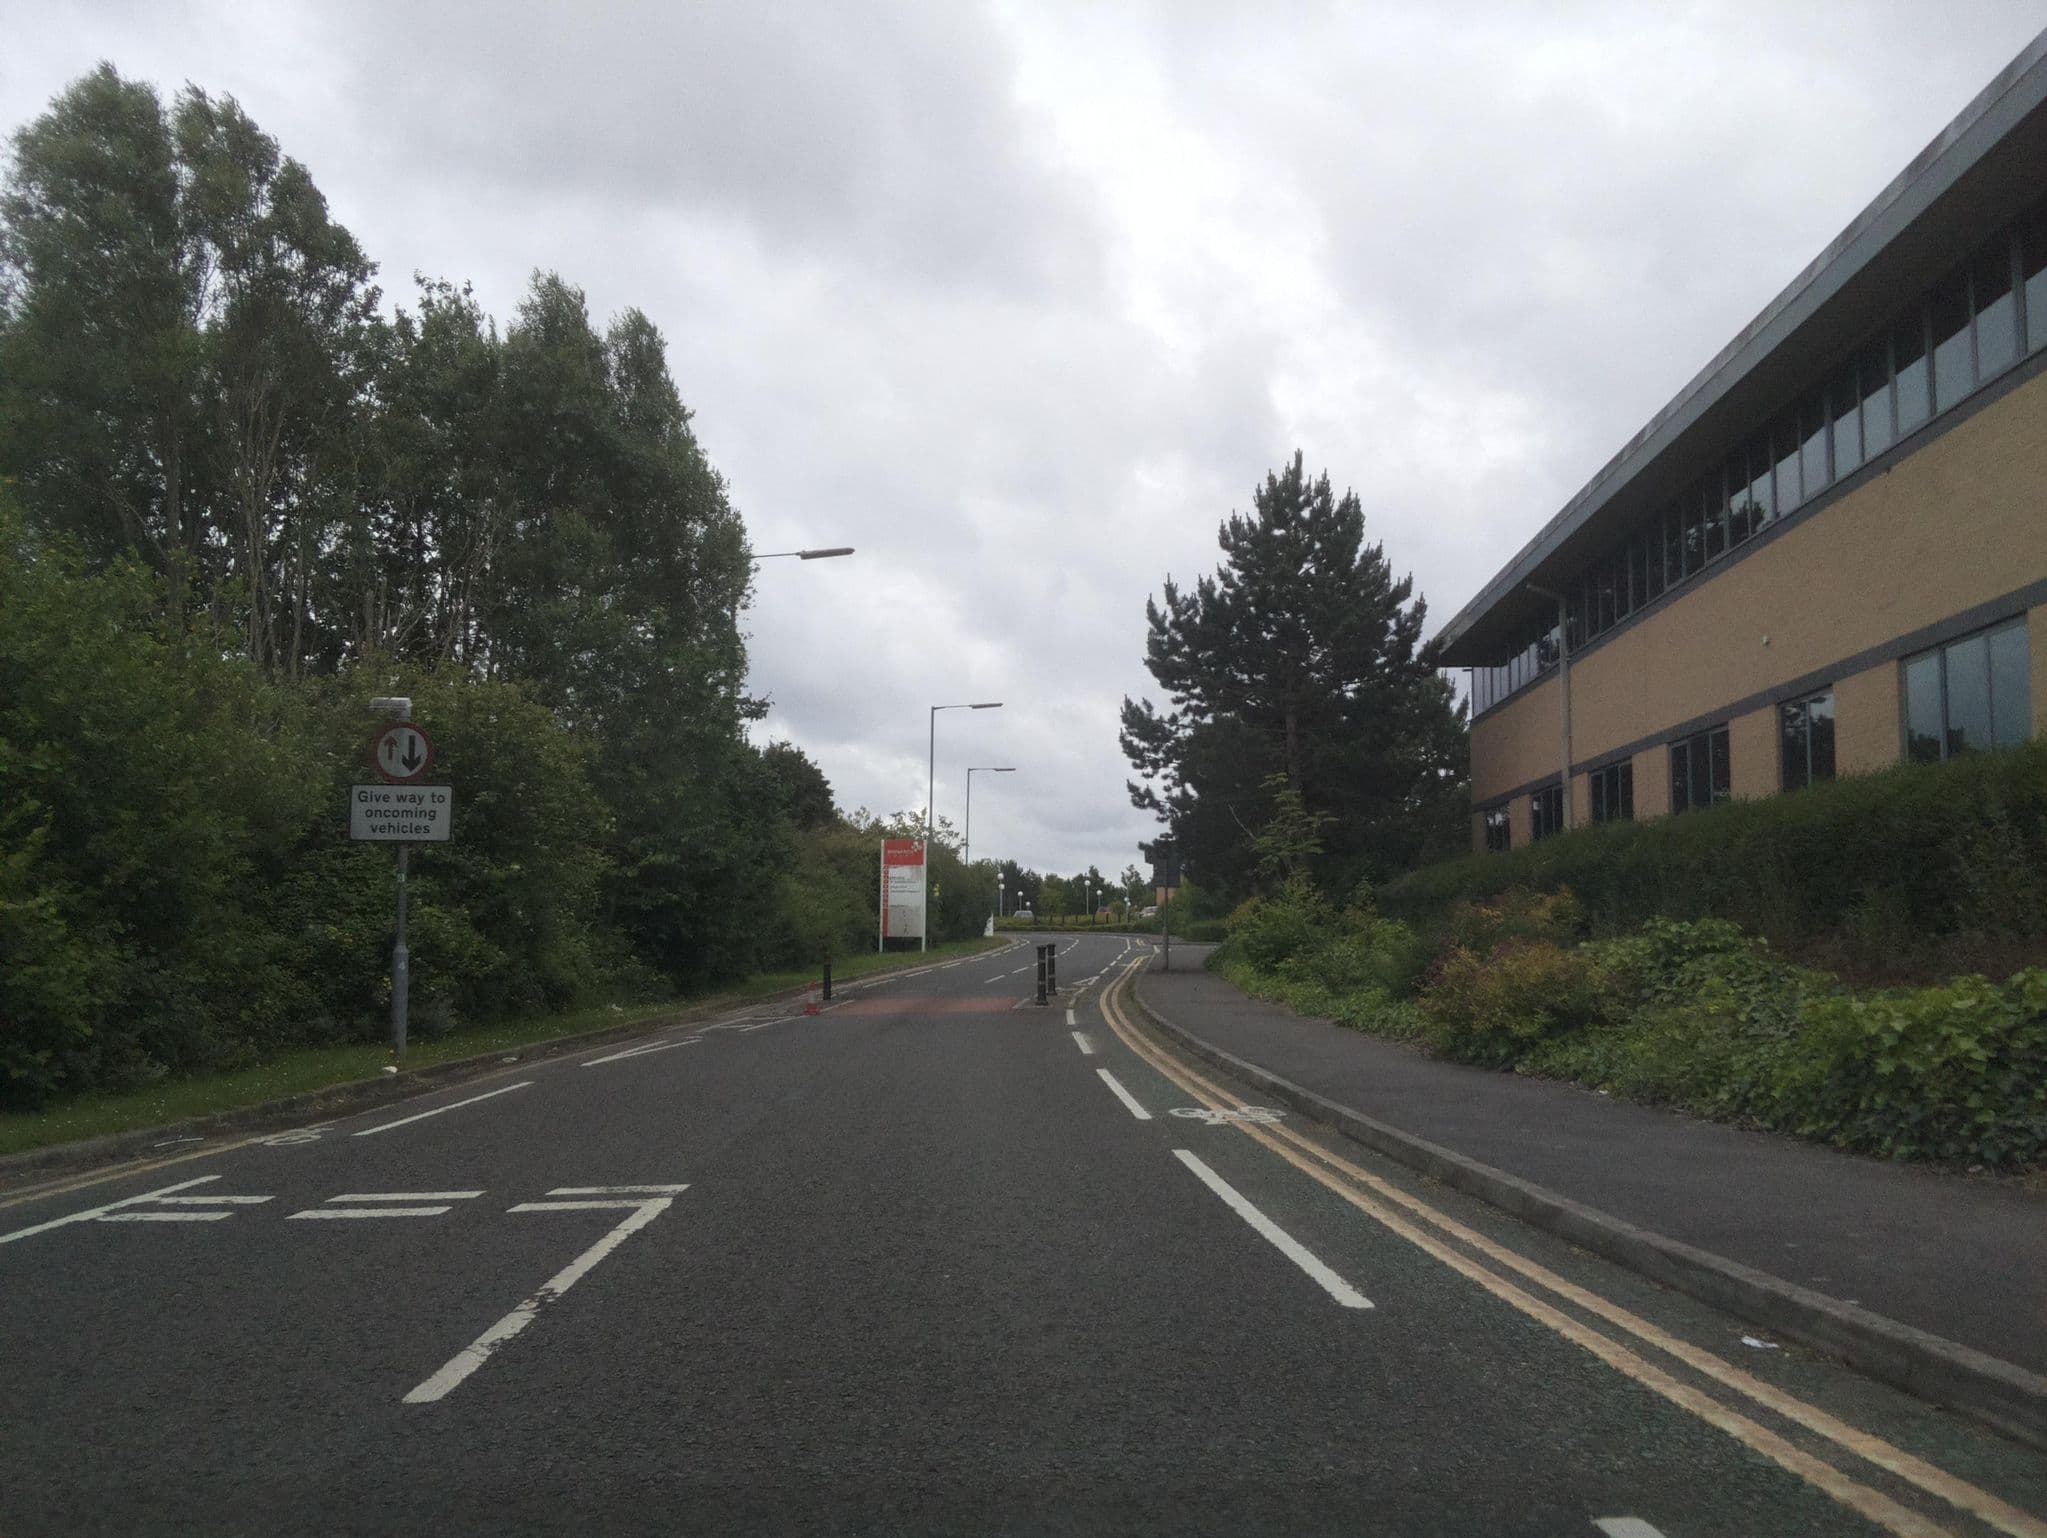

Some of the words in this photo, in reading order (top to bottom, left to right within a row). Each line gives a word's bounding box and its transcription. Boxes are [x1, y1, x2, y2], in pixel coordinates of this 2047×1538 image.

[358, 791, 391, 803] Give
[396, 793, 425, 806] way
[431, 791, 446, 803] to
[365, 807, 437, 821] oncoming
[370, 822, 431, 834] vehicles
